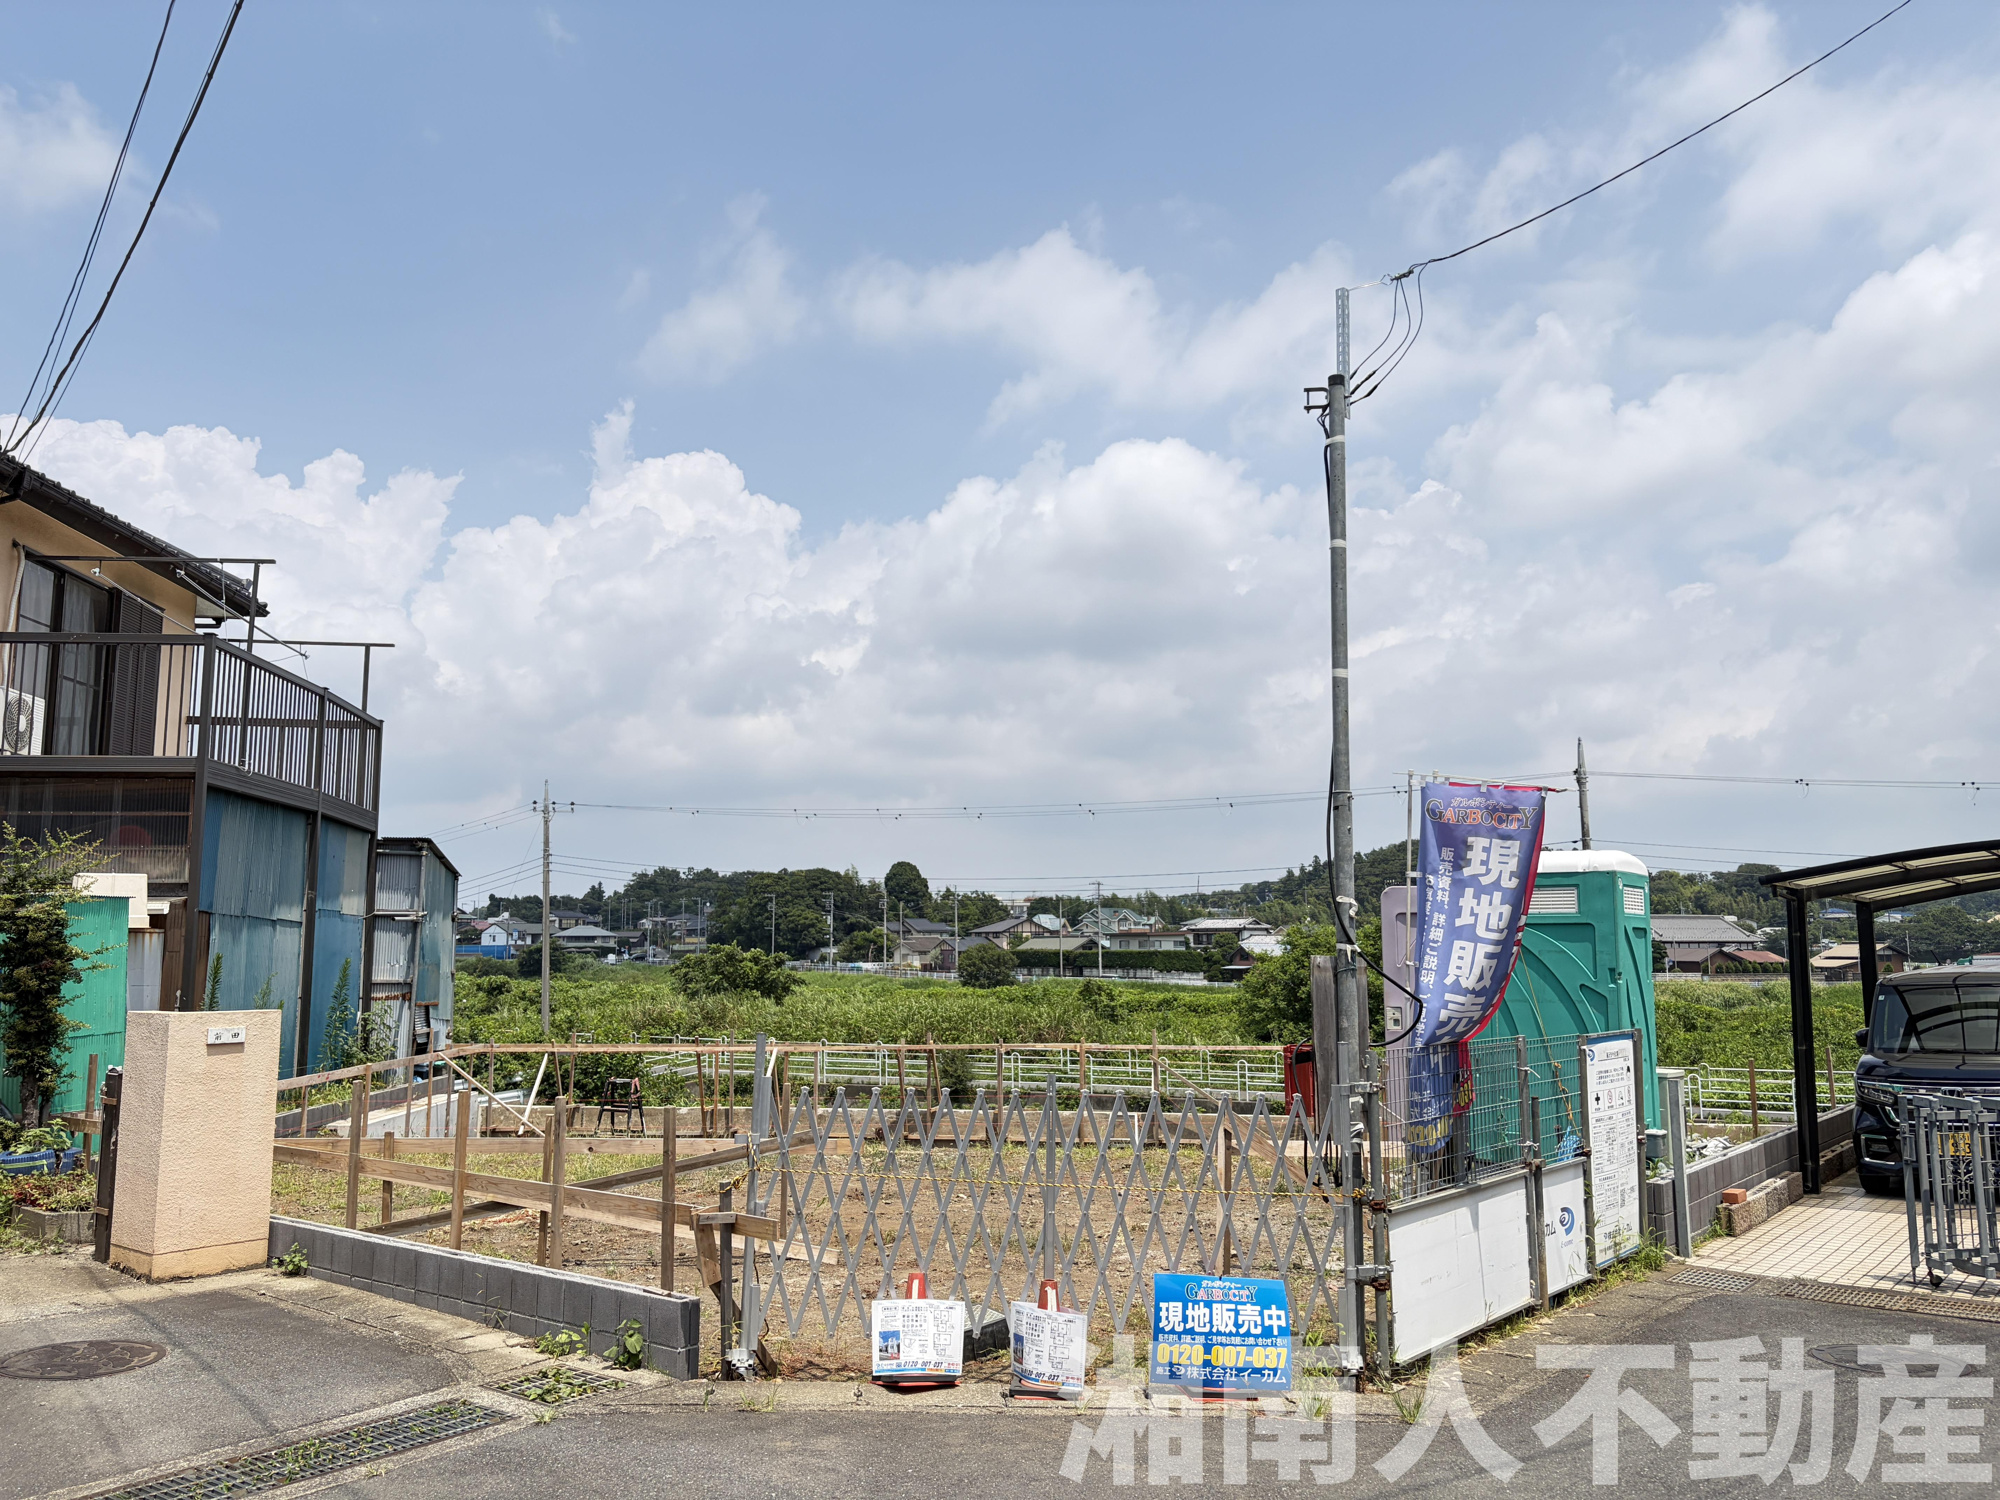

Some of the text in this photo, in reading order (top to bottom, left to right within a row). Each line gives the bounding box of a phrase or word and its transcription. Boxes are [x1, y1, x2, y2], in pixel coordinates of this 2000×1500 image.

[1425, 797, 1539, 830] GARBOCITY
[1451, 797, 1513, 811] ガルボシティー
[1185, 1282, 1258, 1302] GARBOCITY
[1158, 1301, 1287, 1336] 現地販売中
[1156, 1343, 1288, 1368] 0120-007-037
[1186, 1367, 1287, 1384] 株式会社イーカム
